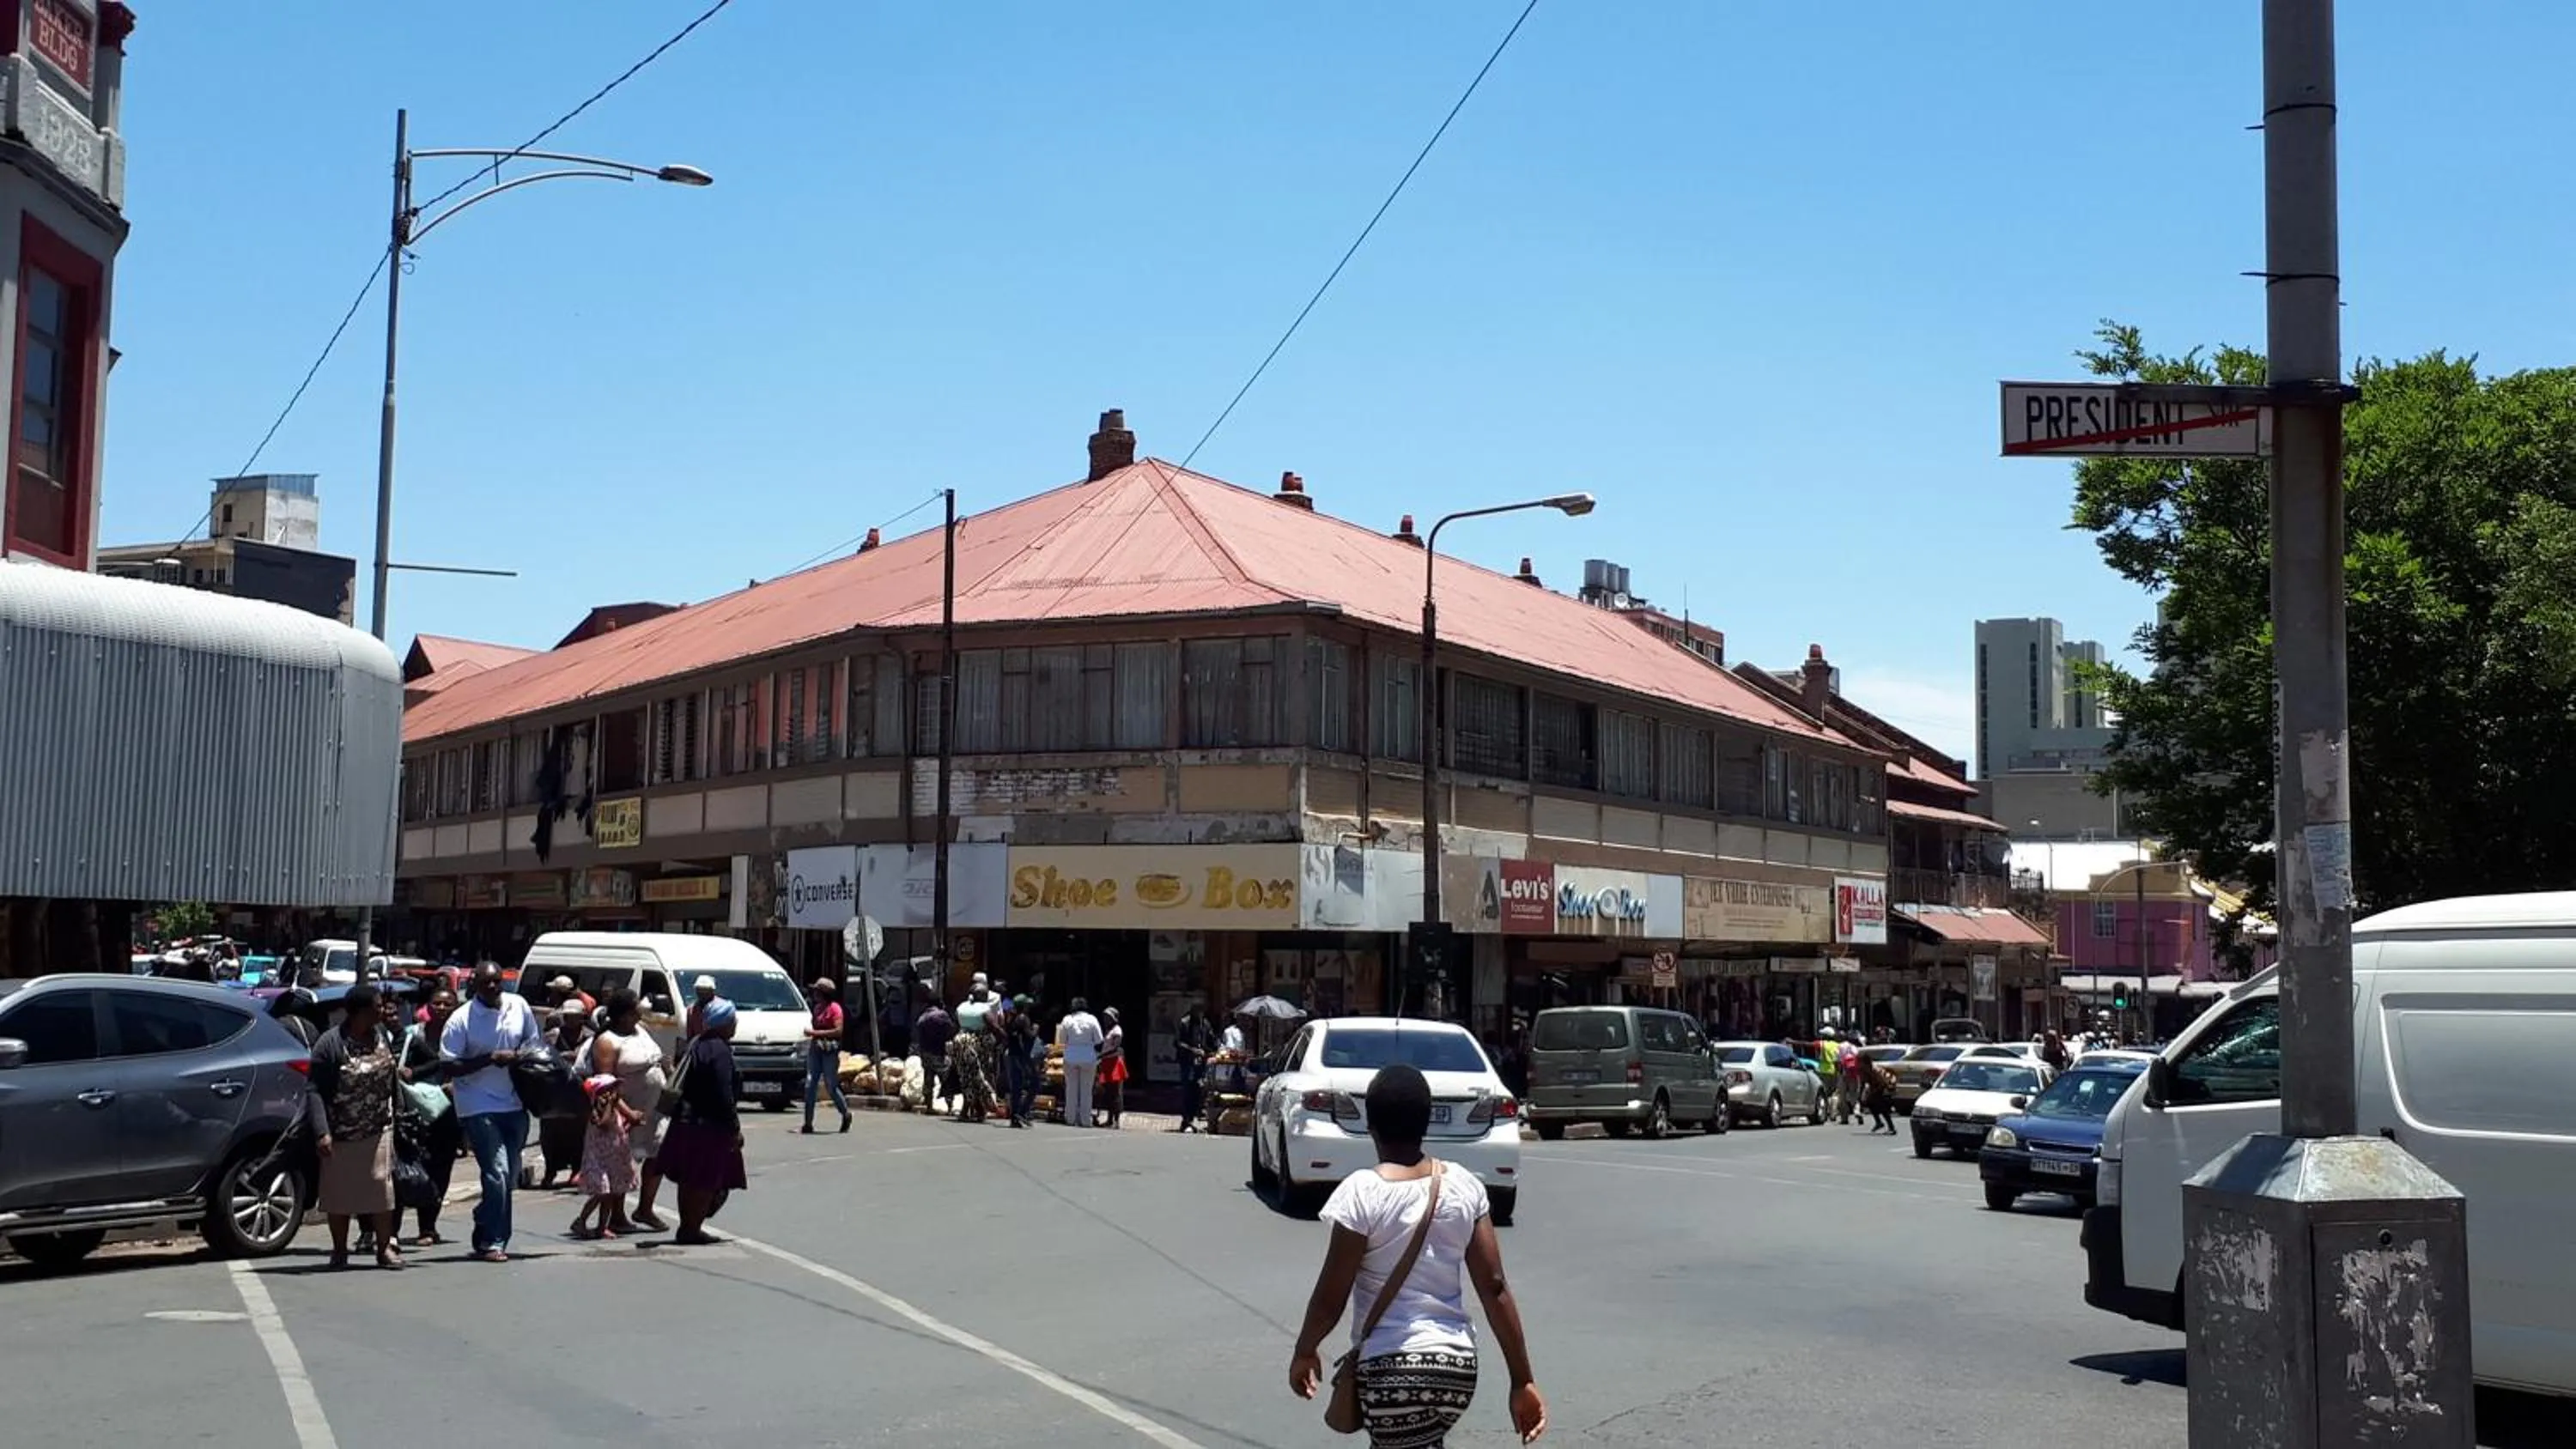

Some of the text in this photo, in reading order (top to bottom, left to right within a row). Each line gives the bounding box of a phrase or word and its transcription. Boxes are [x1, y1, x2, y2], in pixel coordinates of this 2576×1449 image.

[39, 17, 78, 71] BLDG
[2026, 395, 2184, 446] PRESIDENT
[806, 882, 854, 902] CONVERSE
[1009, 864, 1294, 910] Shoe Box
[1500, 874, 1549, 901] Levi's
